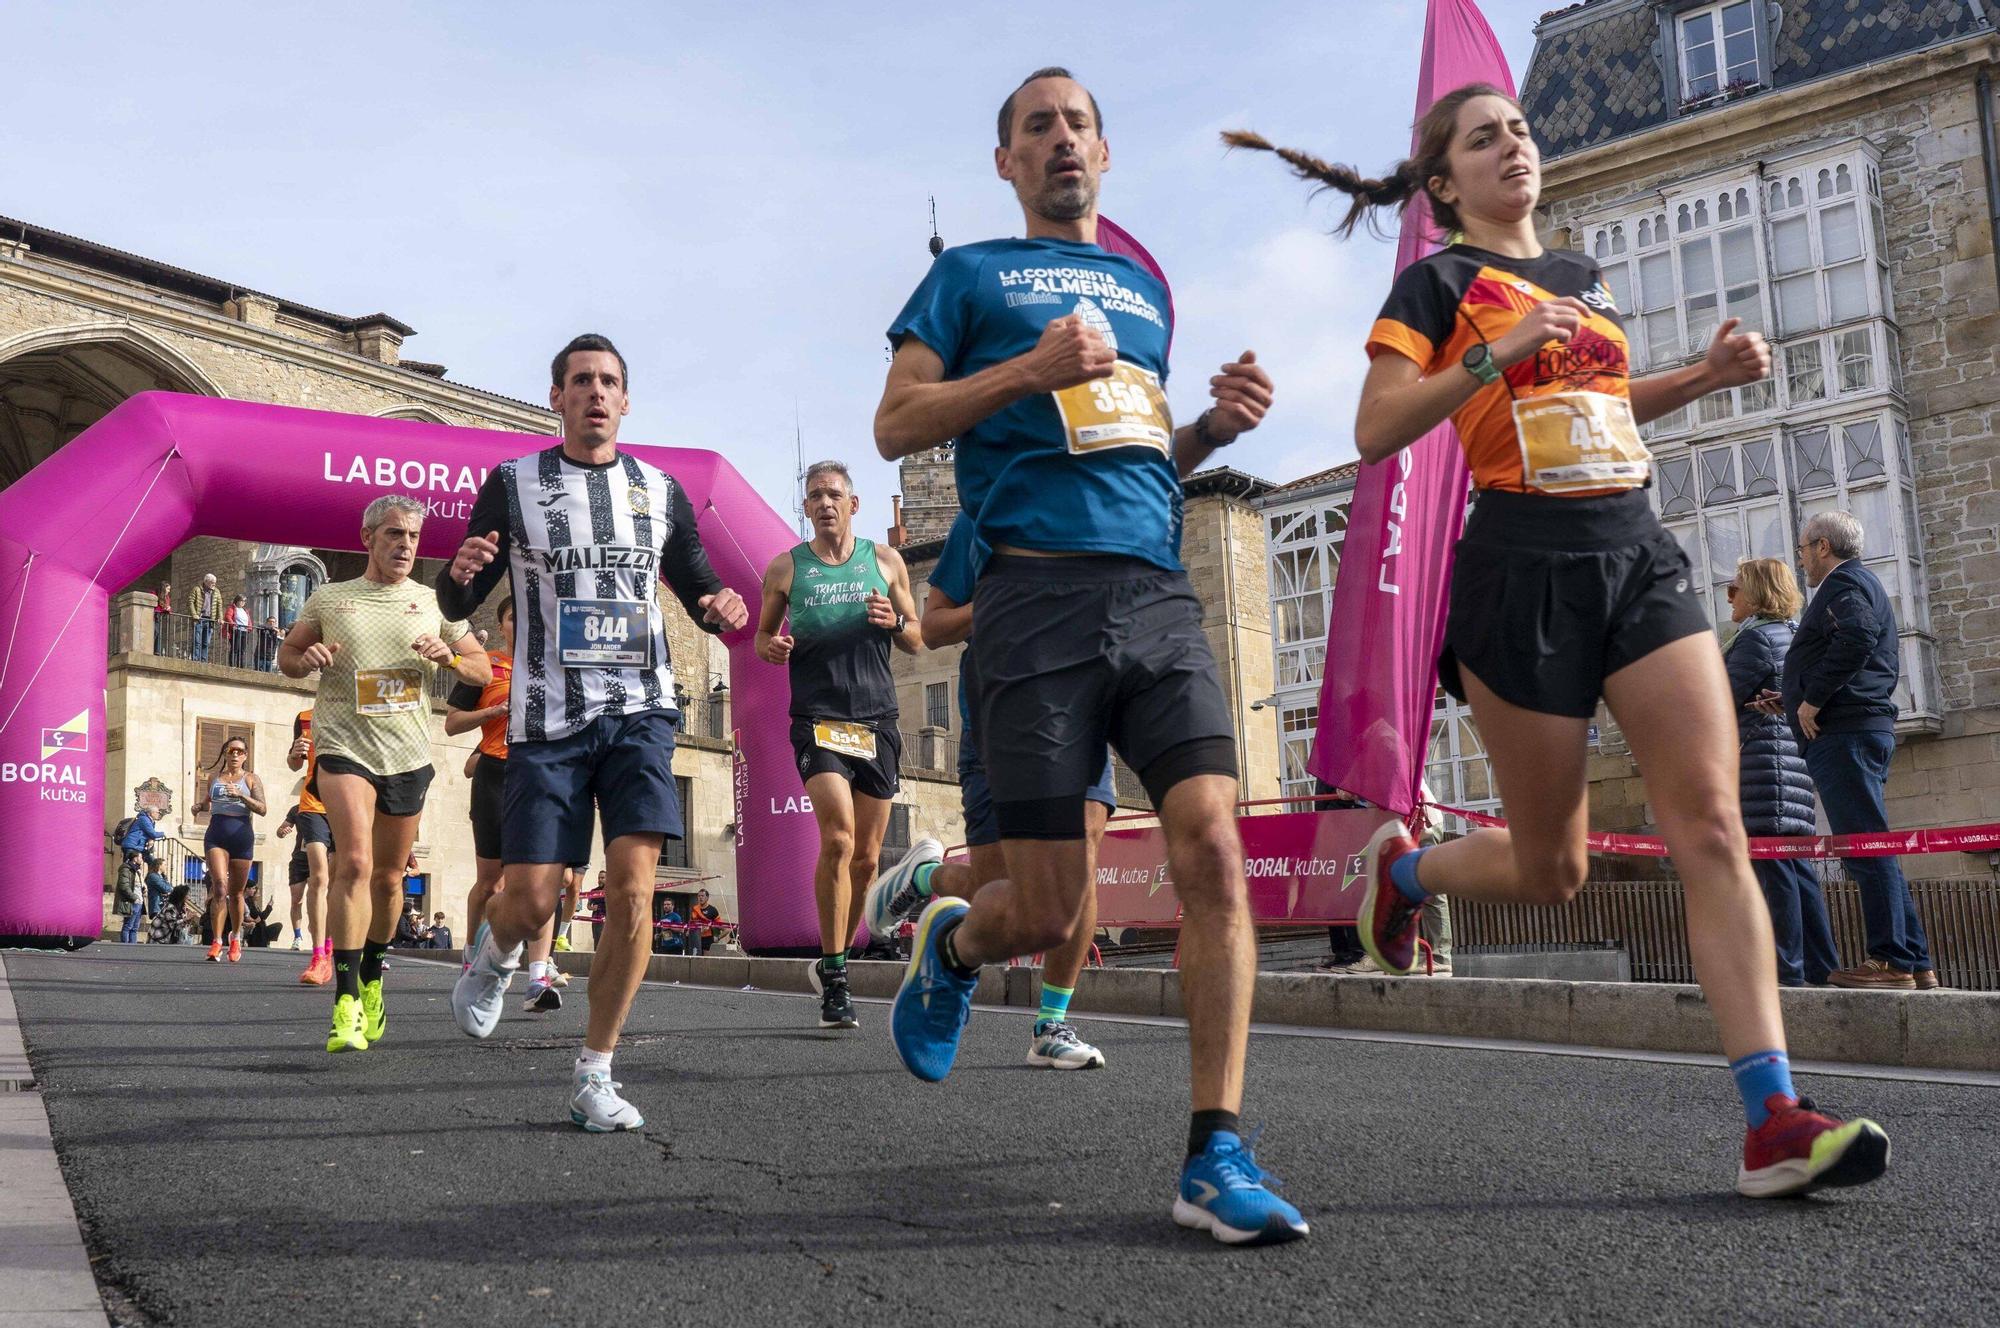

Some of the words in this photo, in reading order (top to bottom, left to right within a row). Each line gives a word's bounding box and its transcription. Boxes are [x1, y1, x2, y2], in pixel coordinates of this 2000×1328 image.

[998, 271, 1021, 281] LA
[1023, 268, 1117, 285] CONQUISTA
[1002, 279, 1017, 287] DE
[1032, 278, 1148, 306] ALMENDRA
[1089, 380, 1153, 416] 356
[1570, 415, 1615, 450] 45
[542, 547, 655, 573] MALEZZA
[813, 581, 864, 595] TRIATLON
[584, 615, 629, 642] 844
[376, 679, 405, 698] 212
[2, 763, 86, 785] BORAL
[41, 786, 86, 803] kutxa
[735, 767, 744, 847] LABORAL
[771, 796, 814, 815] LAB
[1120, 867, 1149, 884] kutxa
[1245, 857, 1290, 878] BORAL
[1294, 857, 1337, 876] kutxa
